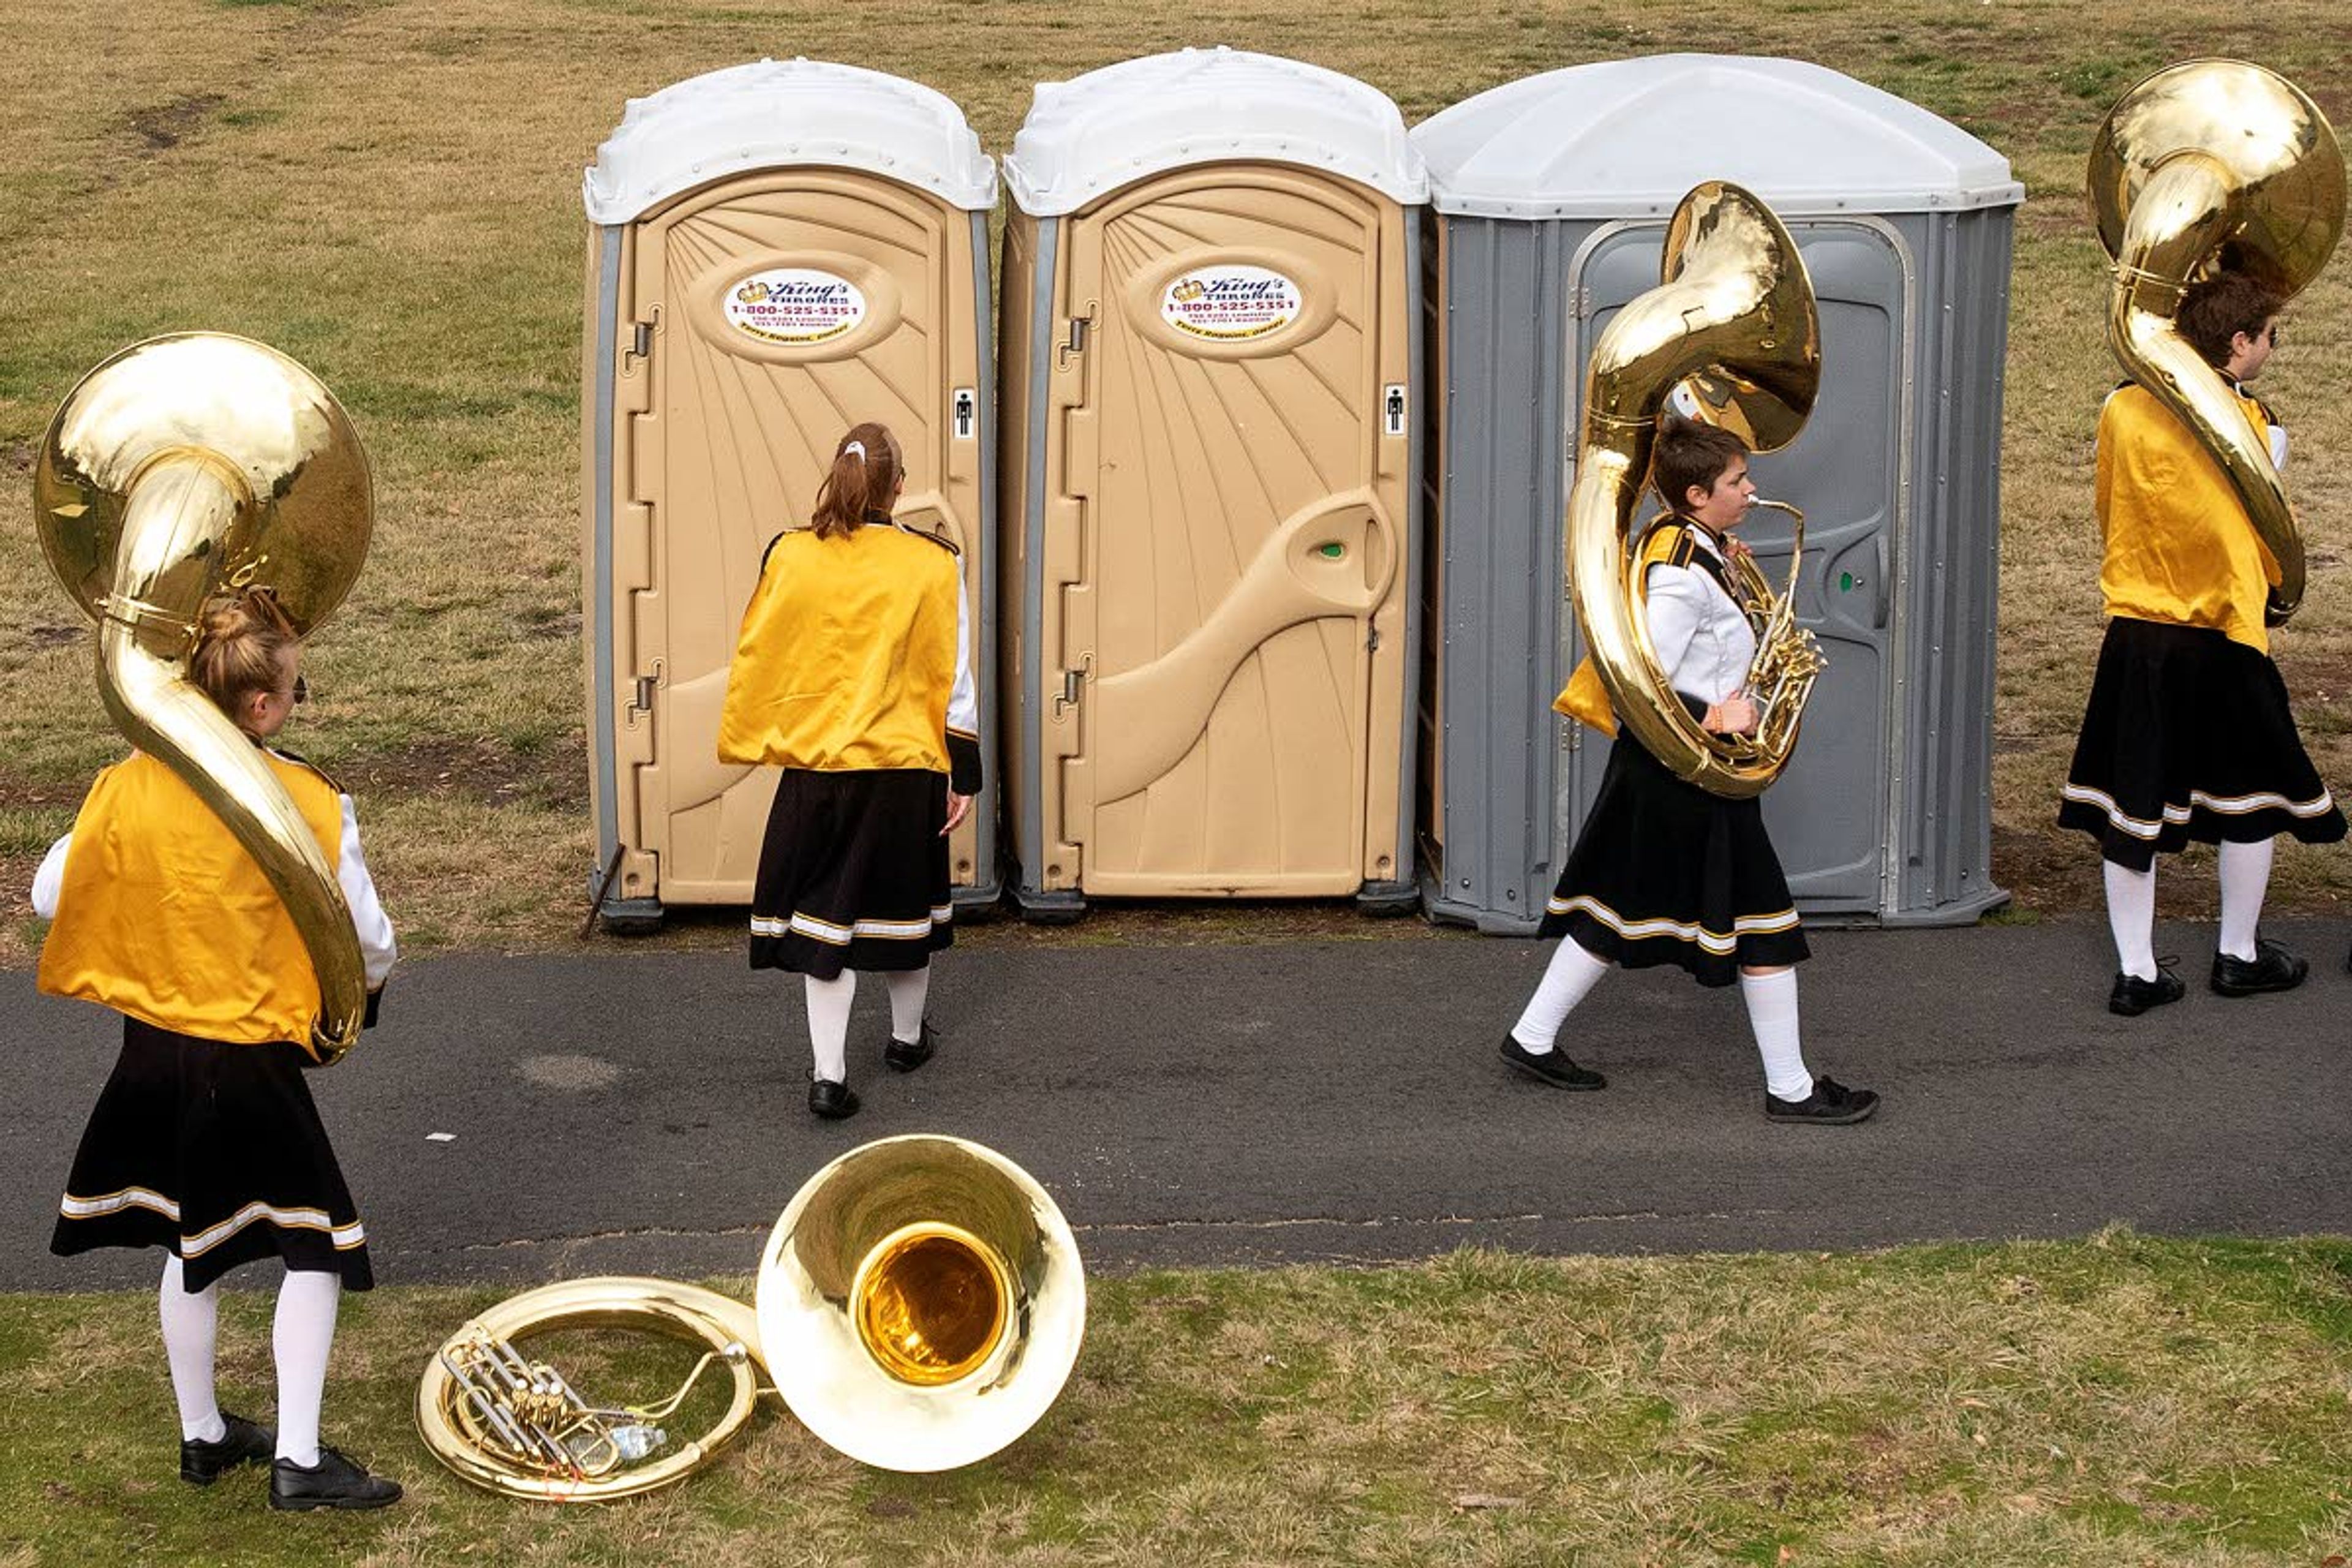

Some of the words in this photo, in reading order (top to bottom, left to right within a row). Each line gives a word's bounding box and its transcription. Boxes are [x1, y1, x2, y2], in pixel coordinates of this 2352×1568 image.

[769, 281, 848, 296] King's
[1203, 277, 1284, 294] King's
[769, 295, 849, 304] THRONES
[1204, 292, 1285, 301] THRONES
[731, 305, 859, 315] 1-800-525-5351
[1167, 300, 1295, 312] 1-800-525-5351
